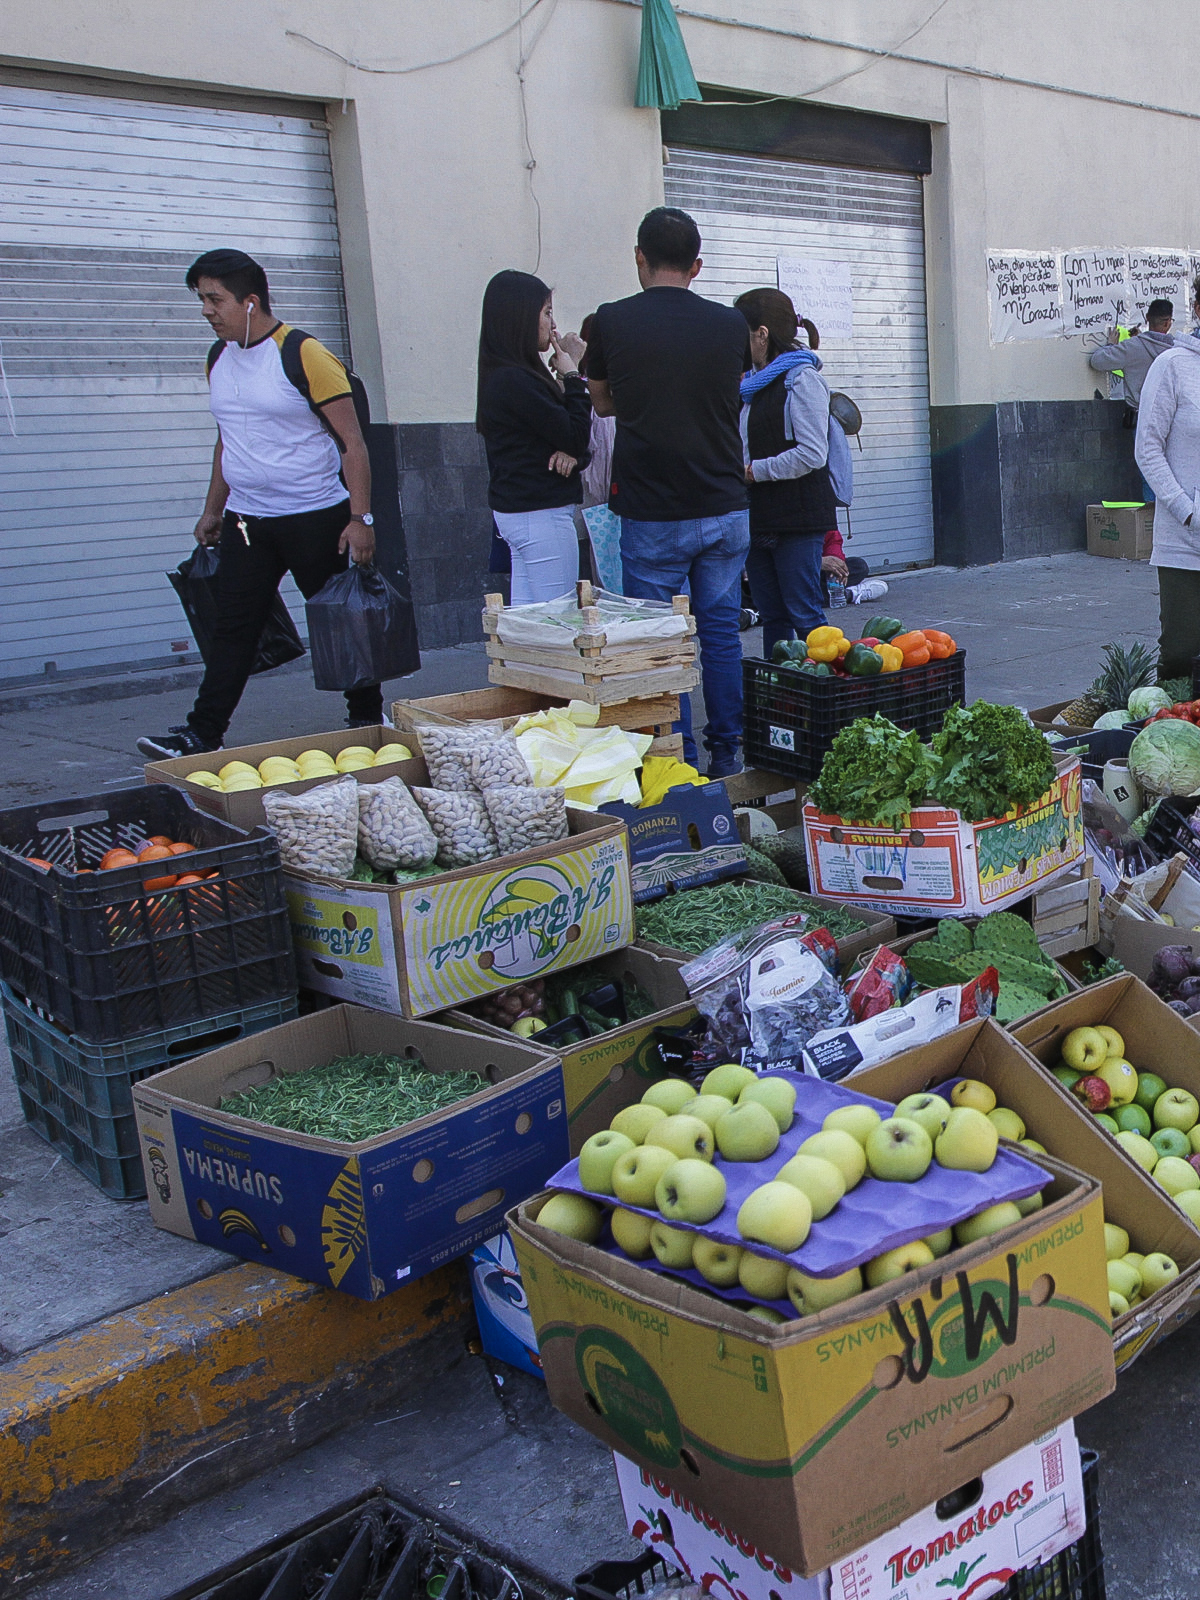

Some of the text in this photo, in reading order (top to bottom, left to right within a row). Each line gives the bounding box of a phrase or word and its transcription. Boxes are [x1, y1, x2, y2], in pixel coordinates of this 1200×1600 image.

[631, 816, 678, 837] BONANZA
[1015, 805, 1055, 830] BANANAS
[851, 834, 903, 845] BANANAS
[592, 850, 624, 871] BANANAS
[981, 871, 1032, 900] PREMIUM
[579, 1036, 636, 1066] BANANAS
[813, 1038, 840, 1055] BLACK
[766, 1059, 792, 1070] BLACK
[183, 1146, 284, 1204] SUPREMA
[430, 1248, 449, 1263] ROSA
[1014, 1214, 1085, 1270] PREMIUM
[982, 1336, 1056, 1395] PREMIUM
[885, 1383, 978, 1450] BANANAS
[885, 1480, 1034, 1587] Tomatoes
